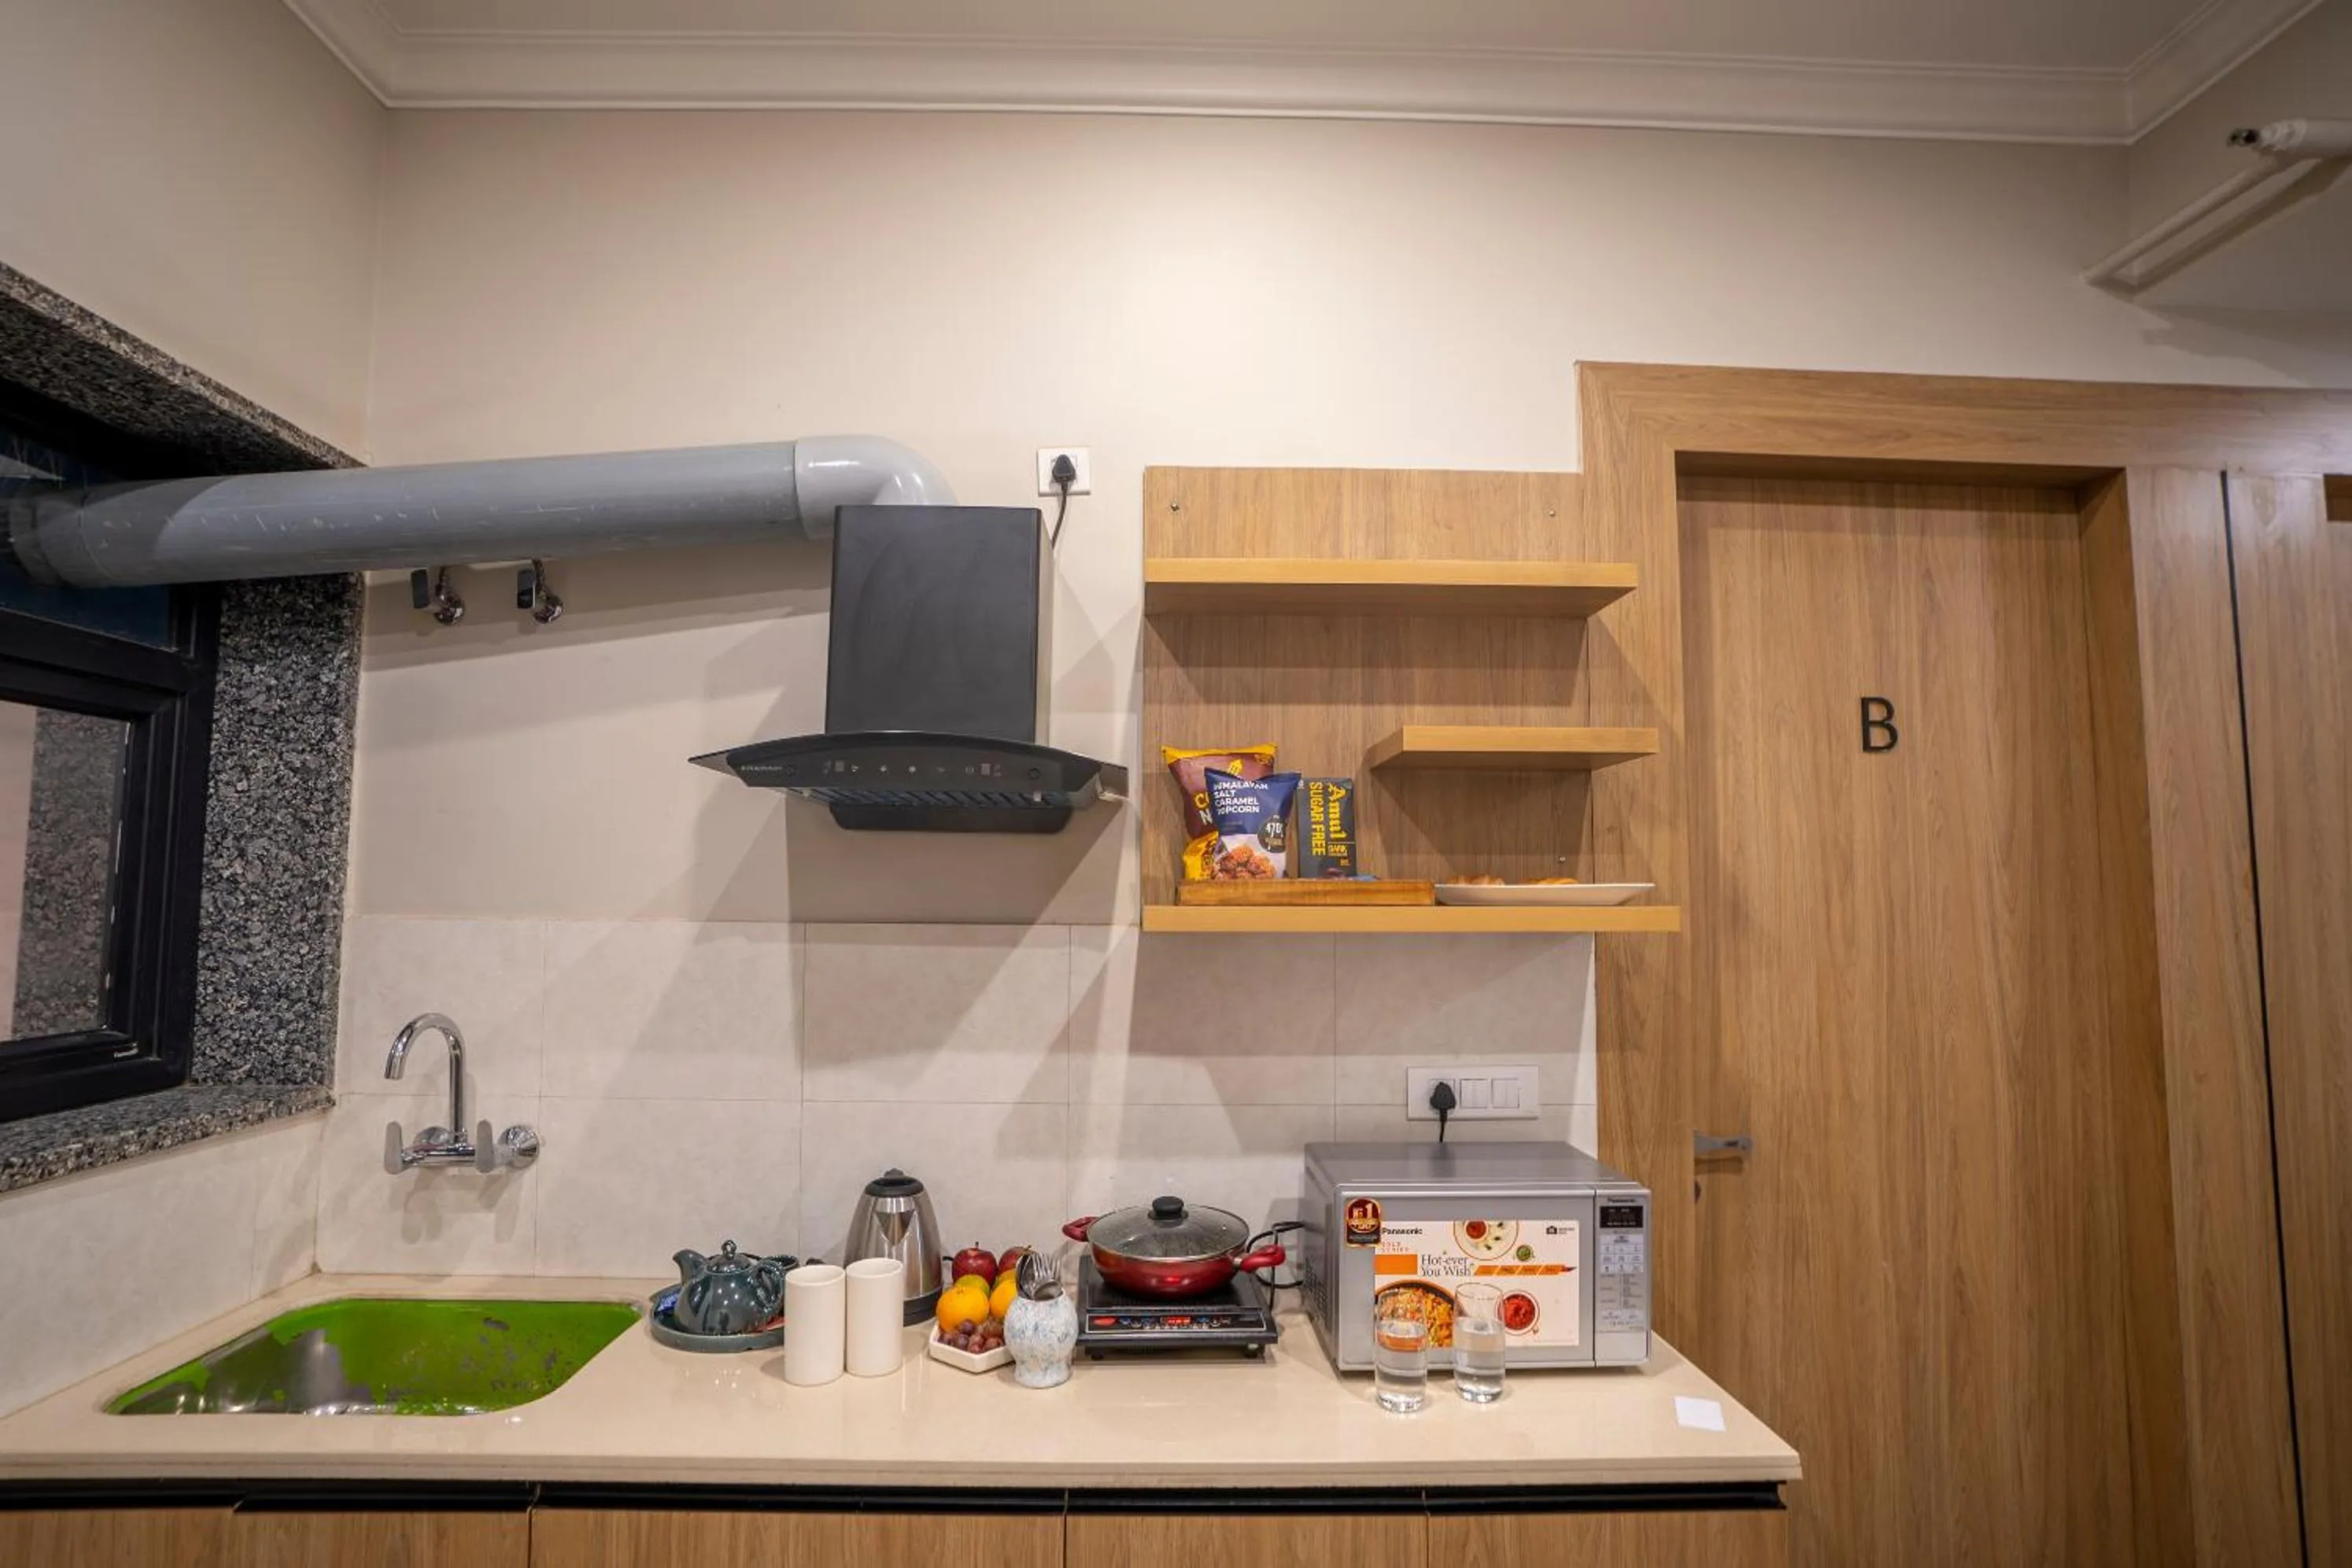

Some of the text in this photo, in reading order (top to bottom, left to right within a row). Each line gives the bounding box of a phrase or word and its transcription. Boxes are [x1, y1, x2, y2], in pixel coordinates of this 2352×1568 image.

[1861, 697, 1898, 752] B
[1214, 790, 1236, 799] SALT
[1215, 797, 1260, 806] CARAMEL
[1327, 783, 1347, 839] Amul
[1309, 781, 1326, 856] SUGAR FREE
[1421, 1254, 1467, 1265] Hot-ever
[1420, 1265, 1471, 1277] You Wish
